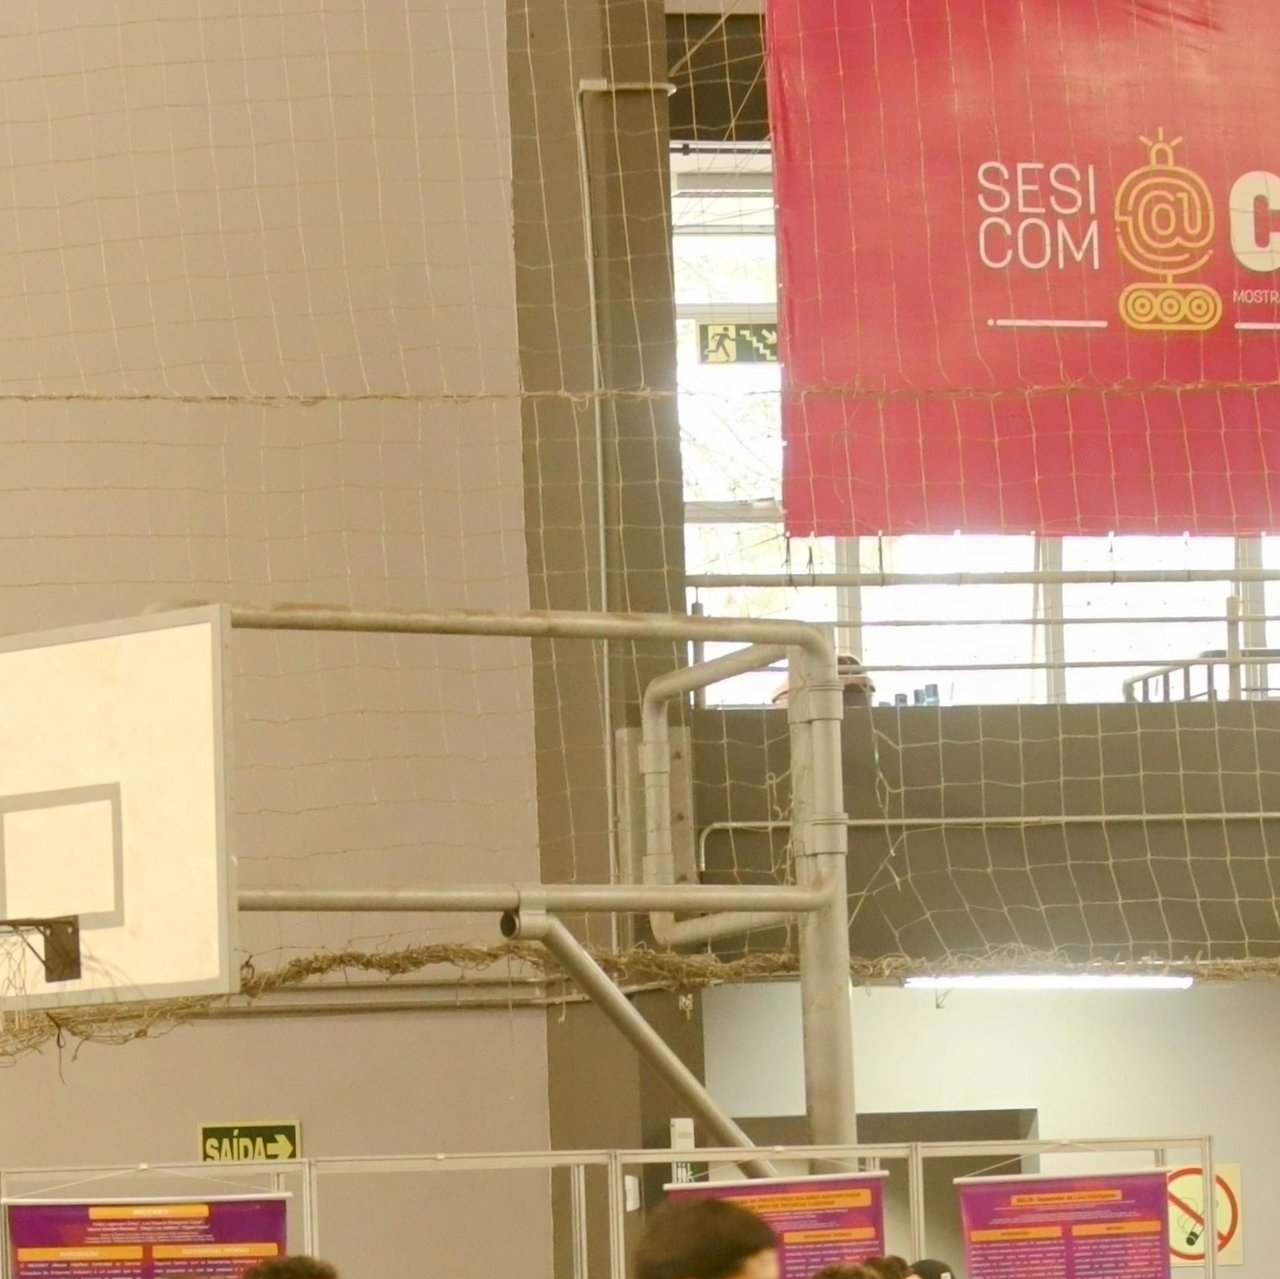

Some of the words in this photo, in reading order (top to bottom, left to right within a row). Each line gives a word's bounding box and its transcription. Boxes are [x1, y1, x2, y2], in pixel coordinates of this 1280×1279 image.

[977, 161, 1096, 215] SESI
[977, 219, 1100, 270] COM
[205, 1129, 266, 1161] SAÍDA
